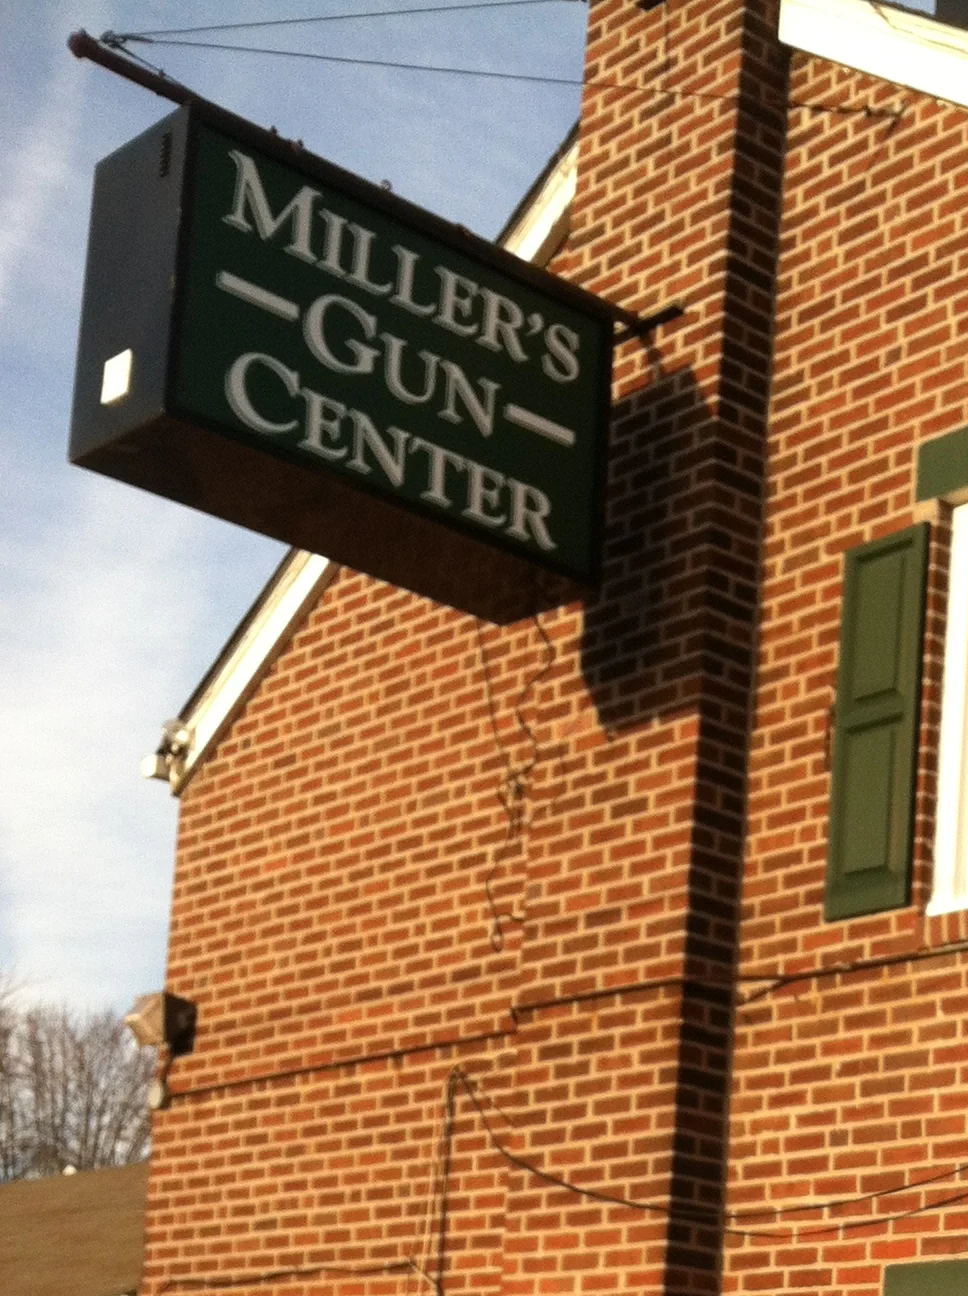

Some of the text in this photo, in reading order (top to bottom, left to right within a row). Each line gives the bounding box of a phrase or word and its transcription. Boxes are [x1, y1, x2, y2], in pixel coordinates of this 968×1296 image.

[222, 150, 580, 382] MILLER'S
[225, 353, 557, 550] CENTER
[303, 294, 500, 437] GUN
